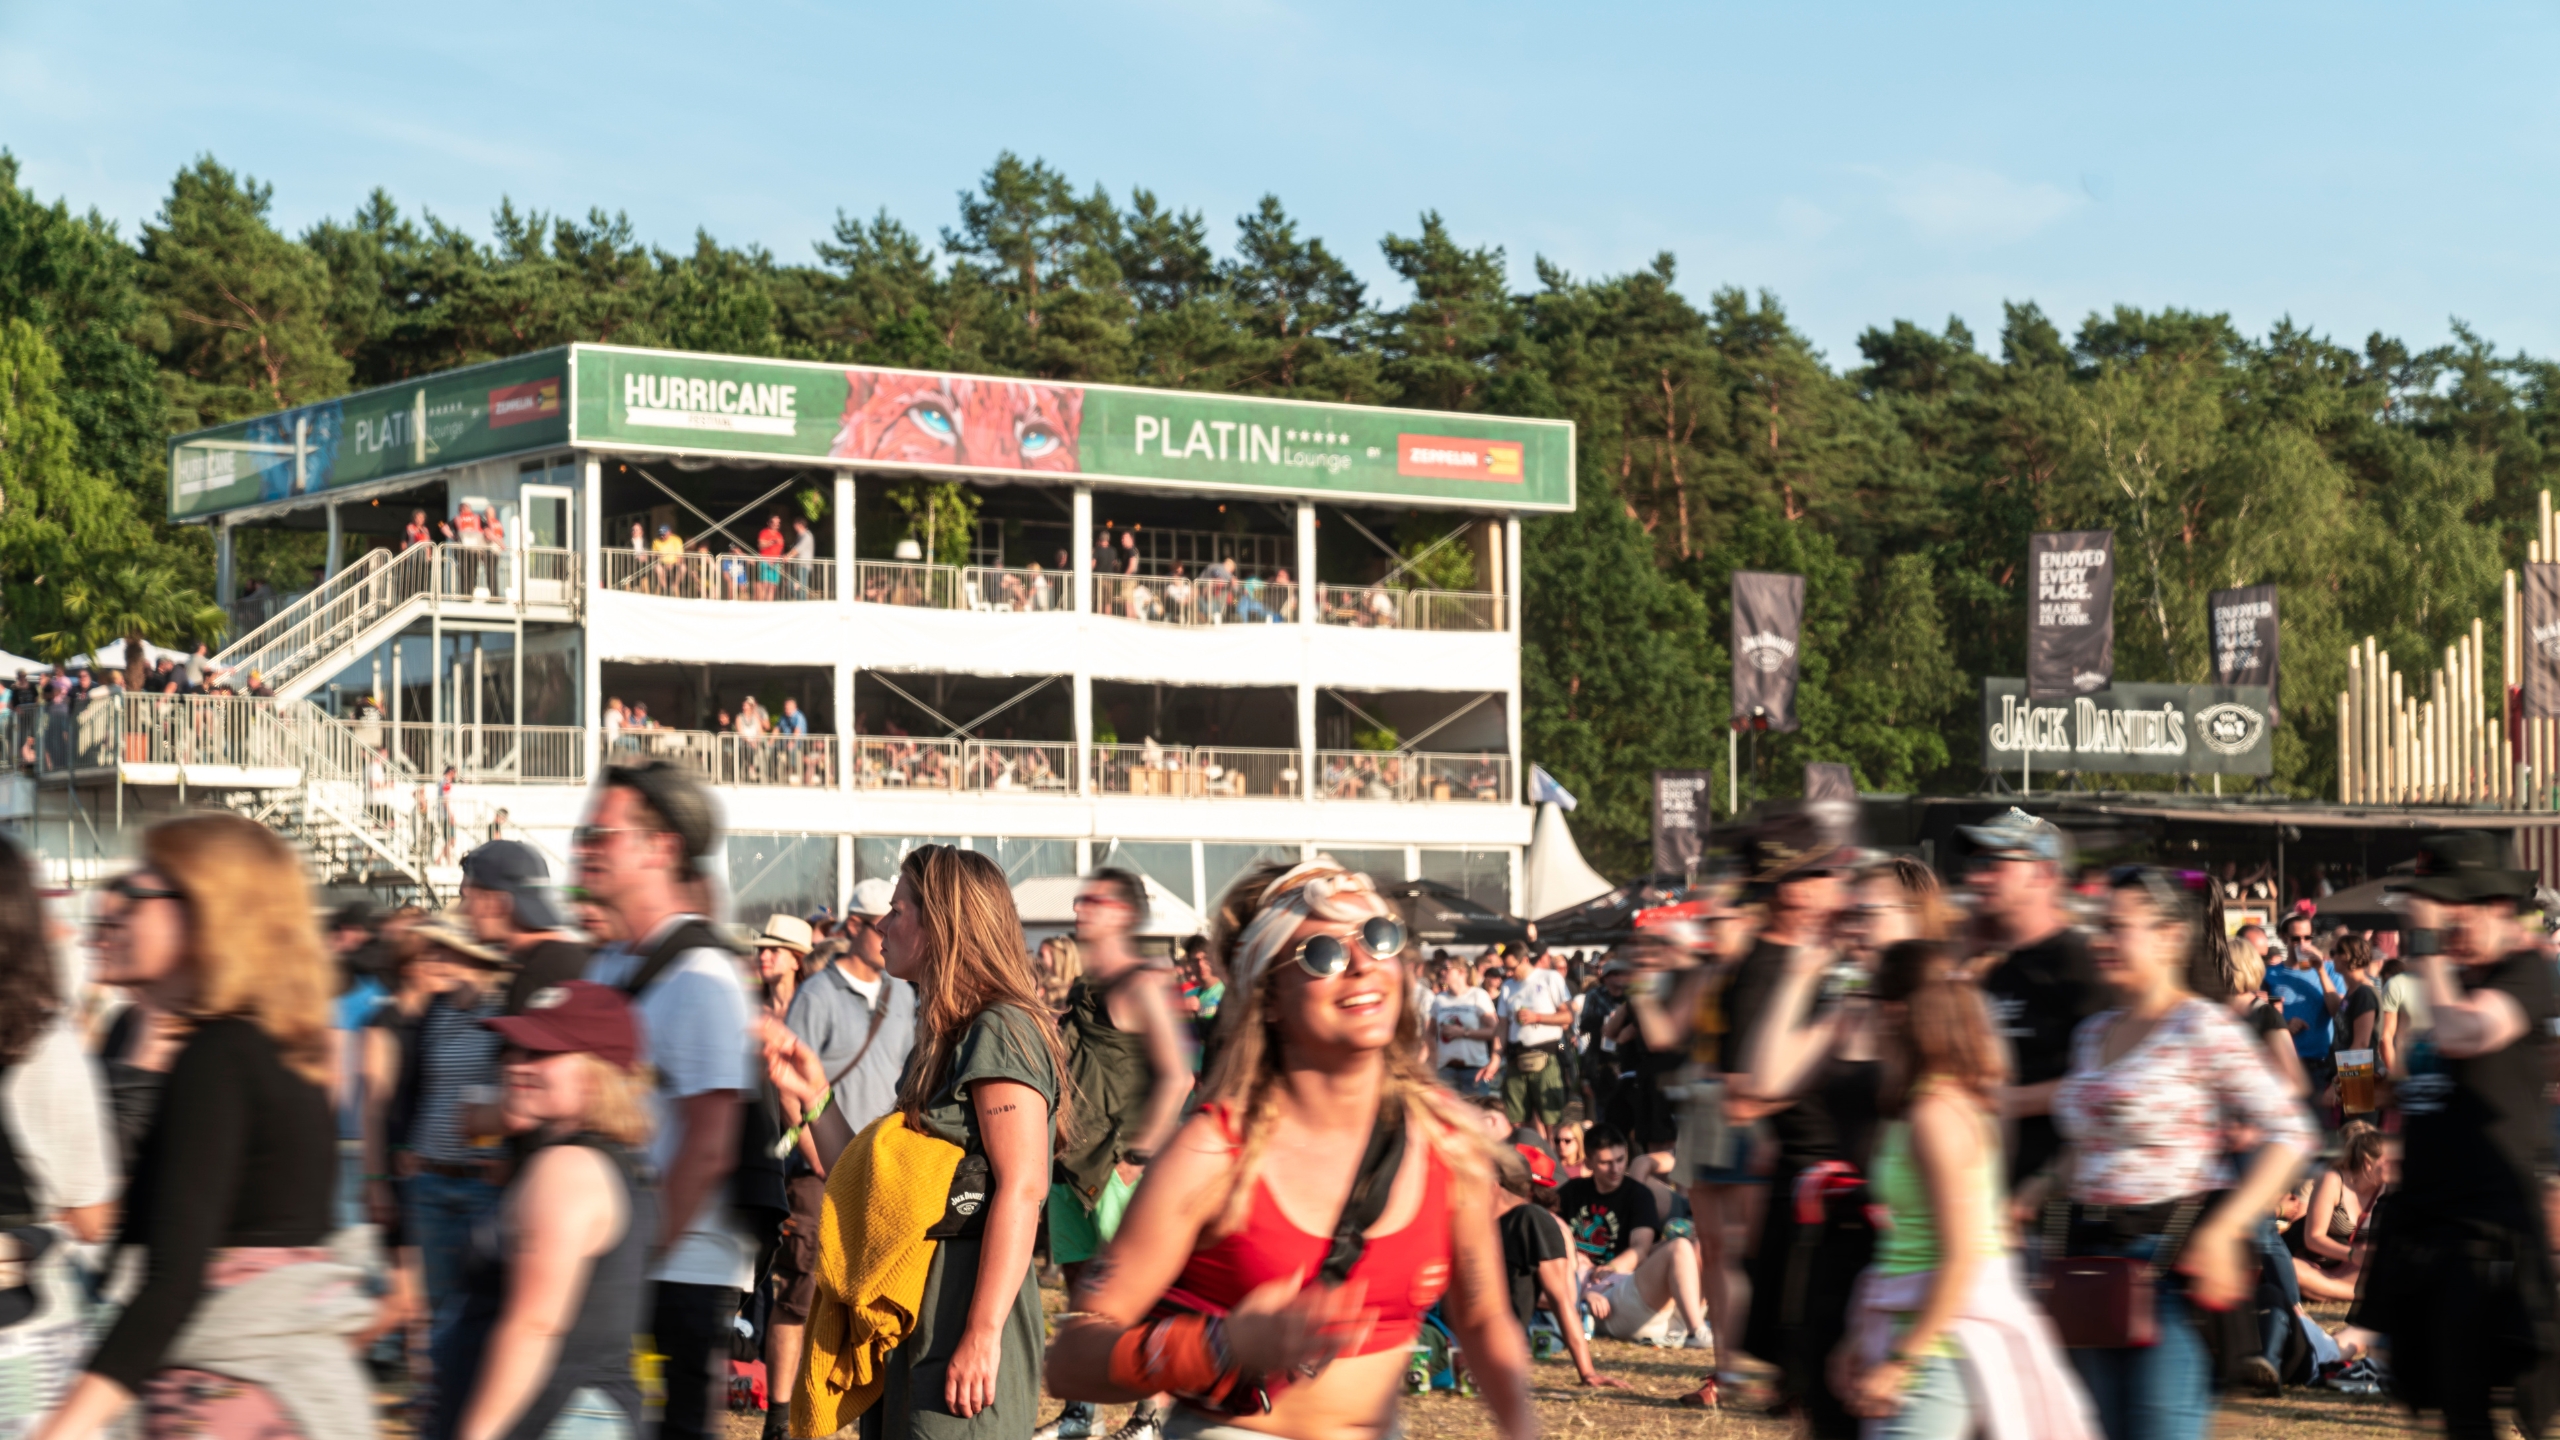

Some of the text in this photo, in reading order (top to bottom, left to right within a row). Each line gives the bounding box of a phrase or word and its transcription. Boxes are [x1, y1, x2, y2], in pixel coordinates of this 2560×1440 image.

[624, 372, 797, 418] HURRICANE
[495, 396, 535, 416] ZEPPELIN
[1135, 414, 1281, 464] PLATIN
[1284, 446, 1352, 475] Lounge
[1409, 447, 1478, 467] ZEPPELIN
[2039, 549, 2106, 568] ENJOYED
[2039, 568, 2088, 585] EVERY
[2039, 584, 2093, 600] PLACE.
[1989, 694, 2187, 756] JACK DANIEL'S
[951, 1191, 985, 1206] JACK DANIEL'S
